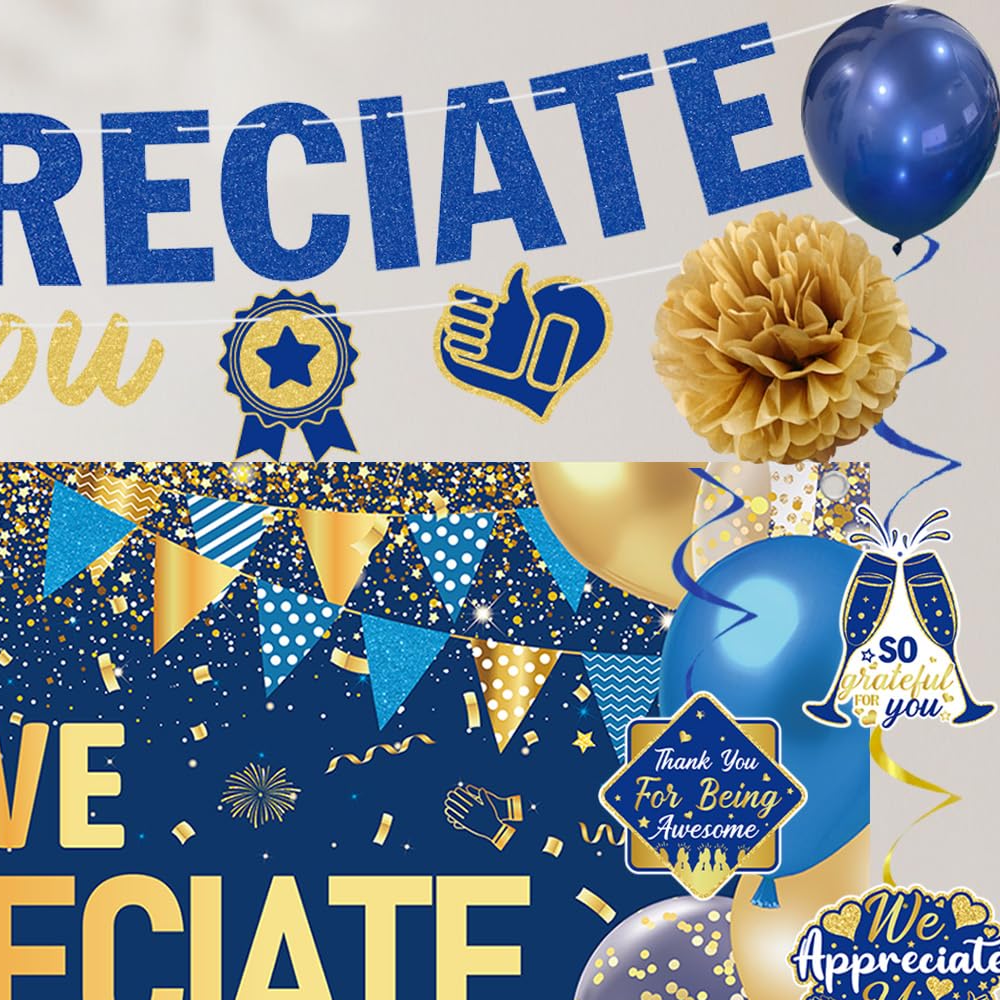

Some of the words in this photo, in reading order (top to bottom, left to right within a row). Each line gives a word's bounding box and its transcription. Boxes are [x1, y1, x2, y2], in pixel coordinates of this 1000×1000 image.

[878, 636, 918, 663] SO
[837, 663, 954, 701] grateful
[854, 694, 880, 706] FOR
[881, 697, 944, 729] you
[654, 747, 714, 772] Thank
[720, 748, 760, 772] You
[634, 775, 684, 812] For
[695, 777, 783, 819] Being
[647, 813, 760, 841] Awesome
[864, 891, 946, 944] We
[793, 927, 1000, 994] Appreciate
